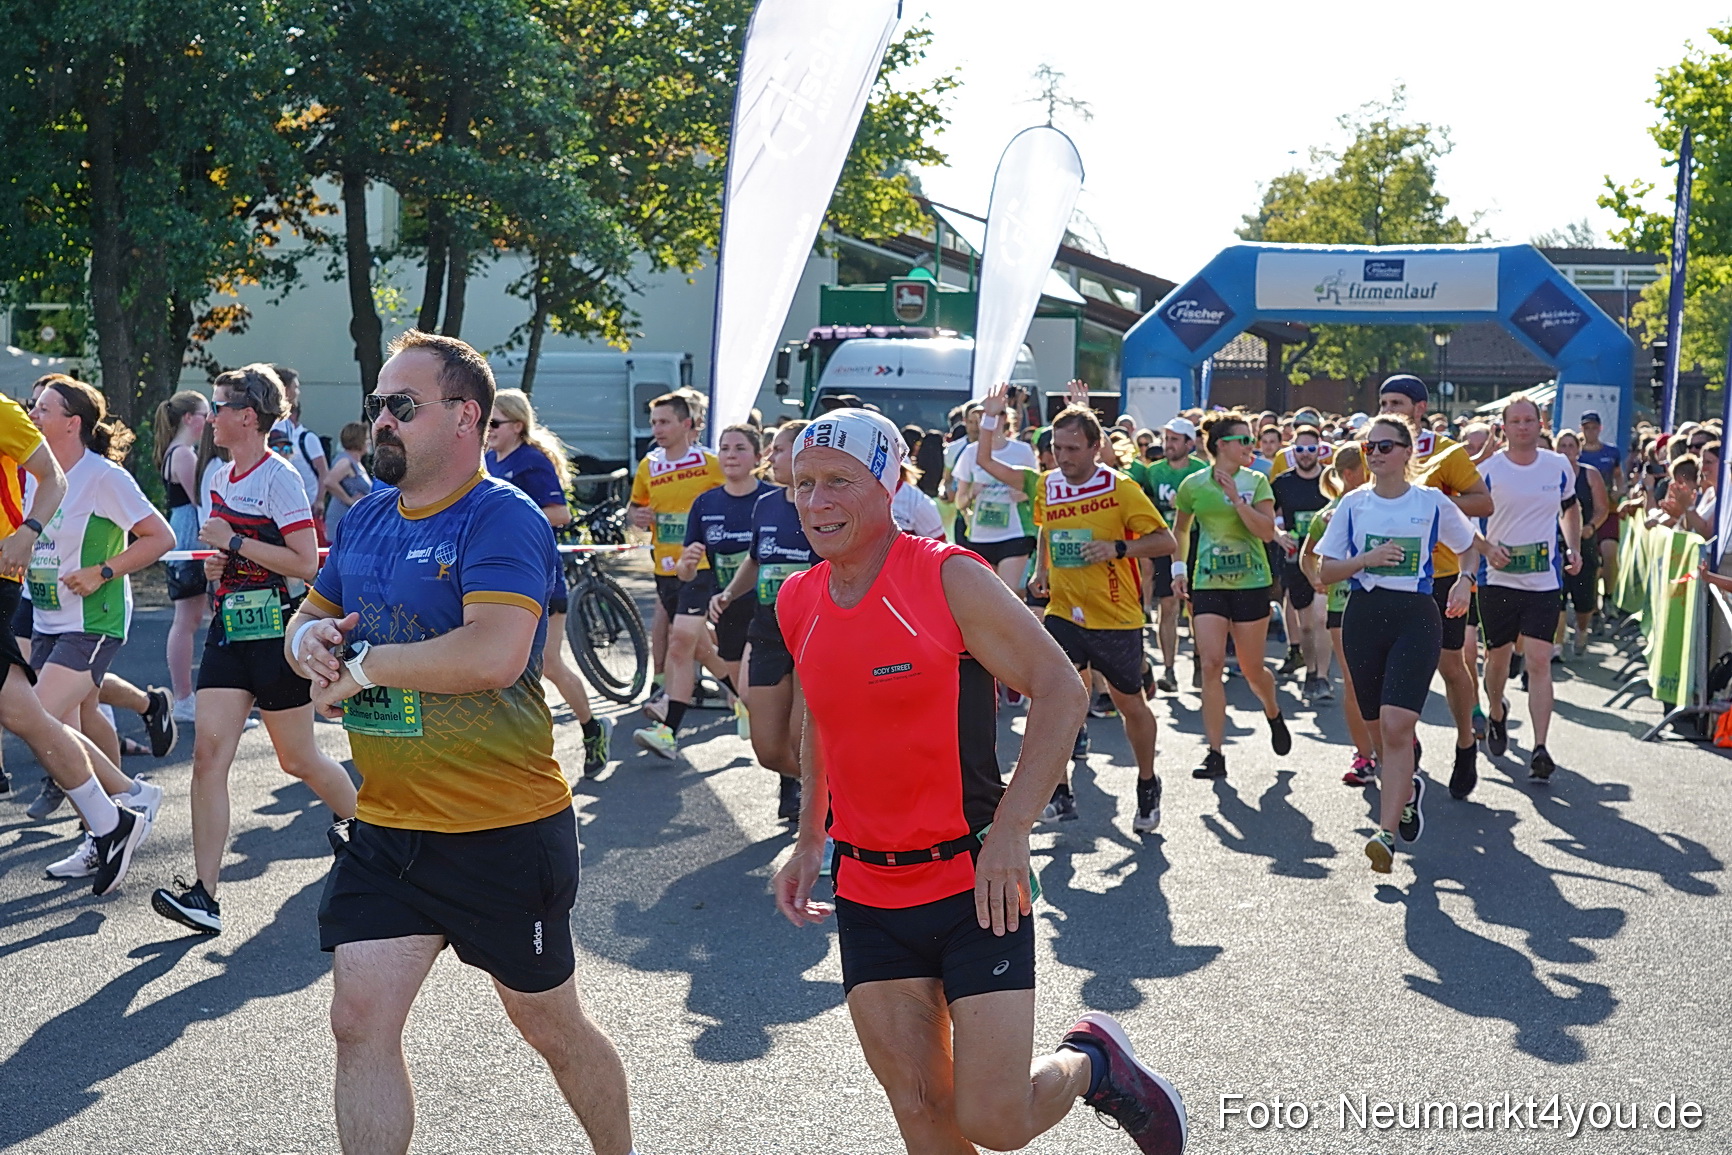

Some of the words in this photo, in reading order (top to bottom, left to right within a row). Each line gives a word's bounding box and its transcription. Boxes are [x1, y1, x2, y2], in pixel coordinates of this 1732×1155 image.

[1348, 281, 1438, 300] firmenlauf
[1175, 303, 1226, 320] Fischer
[650, 474, 674, 487] MAX
[677, 468, 709, 480] BÖGL
[1046, 505, 1077, 521] MAX
[1080, 497, 1120, 514] BÖGL
[1058, 542, 1081, 556] 985
[1222, 555, 1242, 566] 161
[235, 607, 264, 625] 131
[873, 666, 891, 676] BODY
[891, 663, 911, 673] STREET
[349, 706, 373, 720] Schmer
[373, 710, 402, 721] Daniel
[533, 920, 543, 955] adidas
